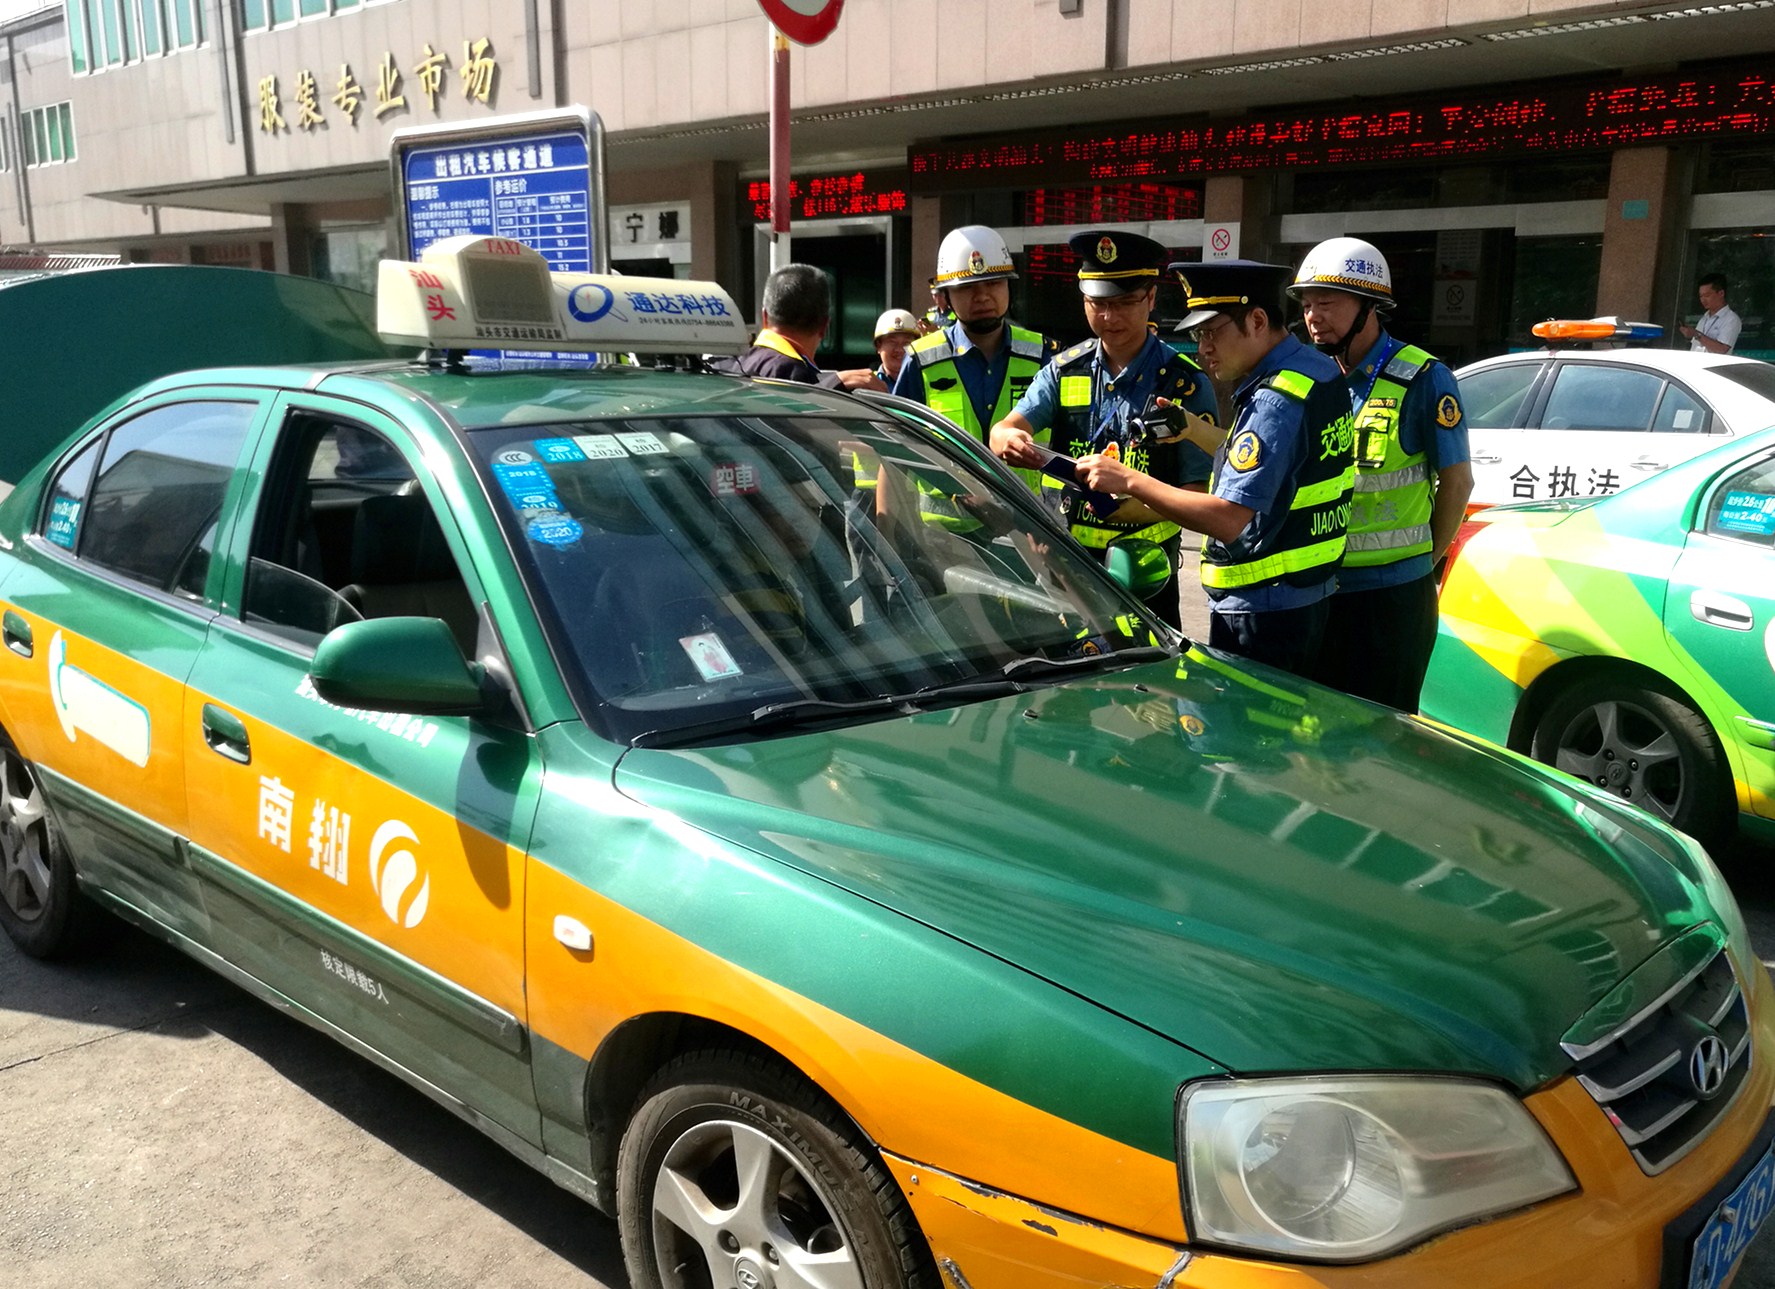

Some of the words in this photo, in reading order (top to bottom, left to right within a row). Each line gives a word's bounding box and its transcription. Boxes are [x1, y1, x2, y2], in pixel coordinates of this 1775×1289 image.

[258, 36, 498, 133] 服装专业市场
[435, 144, 555, 178] 出租汽车候客通道
[484, 238, 522, 256] TAXI
[1345, 257, 1384, 279] 交通执法
[409, 267, 457, 322] 汕头
[624, 291, 731, 316] 通达科技
[547, 451, 584, 462] 2018
[590, 448, 624, 458] 2020
[631, 442, 664, 453] 2017
[258, 775, 351, 886] 南翔
[729, 1091, 853, 1214] MAXIMUS
